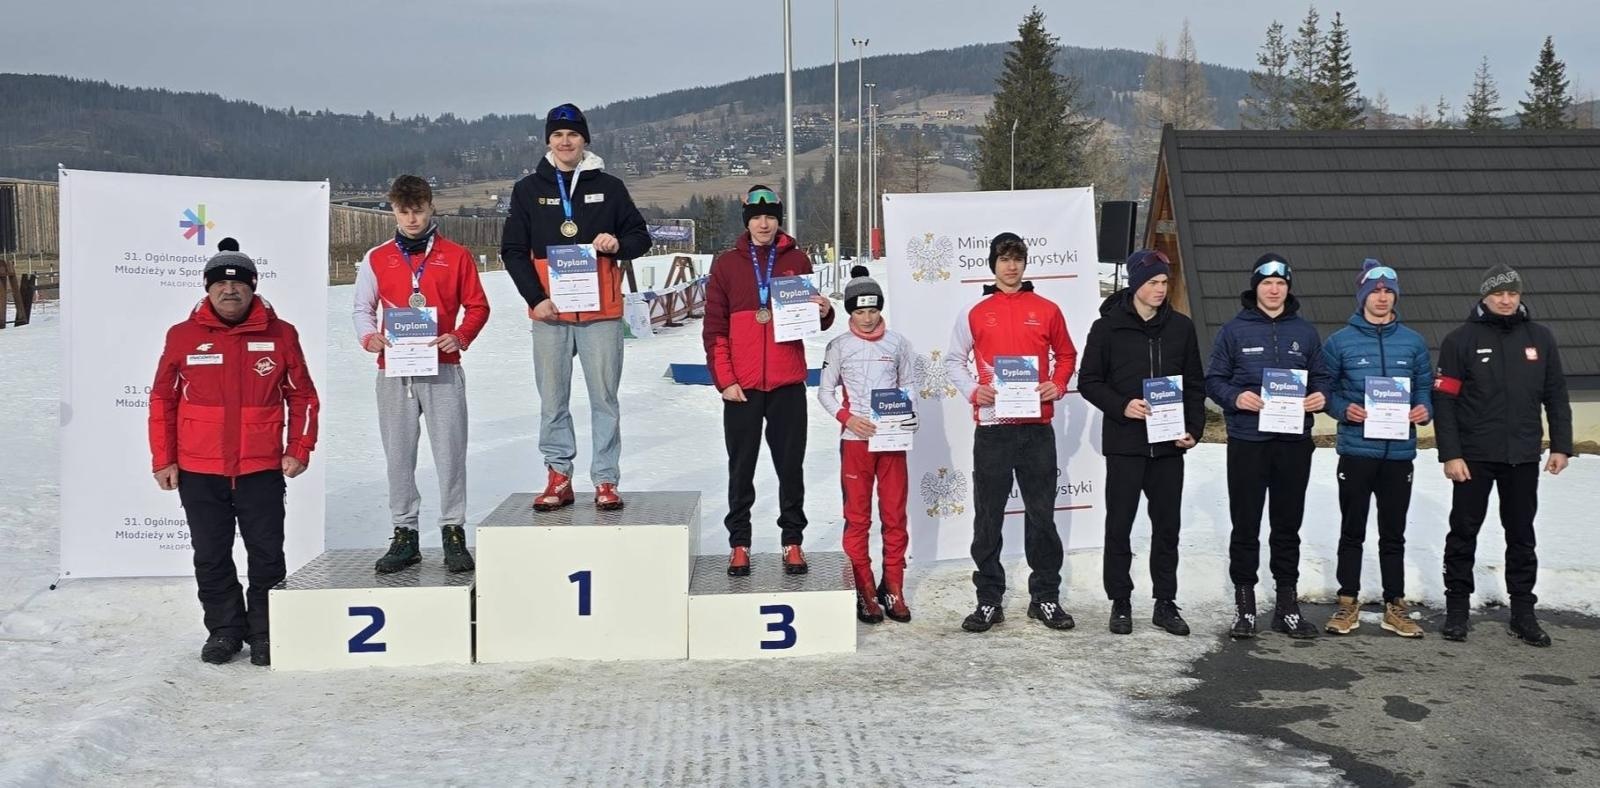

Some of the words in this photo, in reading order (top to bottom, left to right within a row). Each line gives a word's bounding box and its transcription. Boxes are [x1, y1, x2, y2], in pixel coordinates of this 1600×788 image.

[124, 252, 141, 261] 31.
[145, 252, 208, 264] Ogólnopolsk
[557, 258, 588, 269] Dyplom
[959, 255, 991, 271] Spor
[1026, 250, 1078, 266] urystyki
[115, 265, 165, 276] Młodzieży
[780, 289, 810, 300] Dyplom
[394, 322, 428, 332] Dyplom
[1002, 368, 1031, 377] Dyplom
[124, 385, 141, 395] 31.
[1270, 381, 1299, 391] Dyplom
[1150, 390, 1176, 400] Dyplom
[1372, 389, 1402, 398] Dyplom
[879, 401, 906, 410] Dyplom
[124, 517, 141, 526] 31.
[144, 517, 188, 528] Ogólnop
[115, 530, 163, 541] Młodzieży
[567, 570, 592, 616] 1
[347, 606, 387, 654] 2
[759, 604, 797, 650] 3
